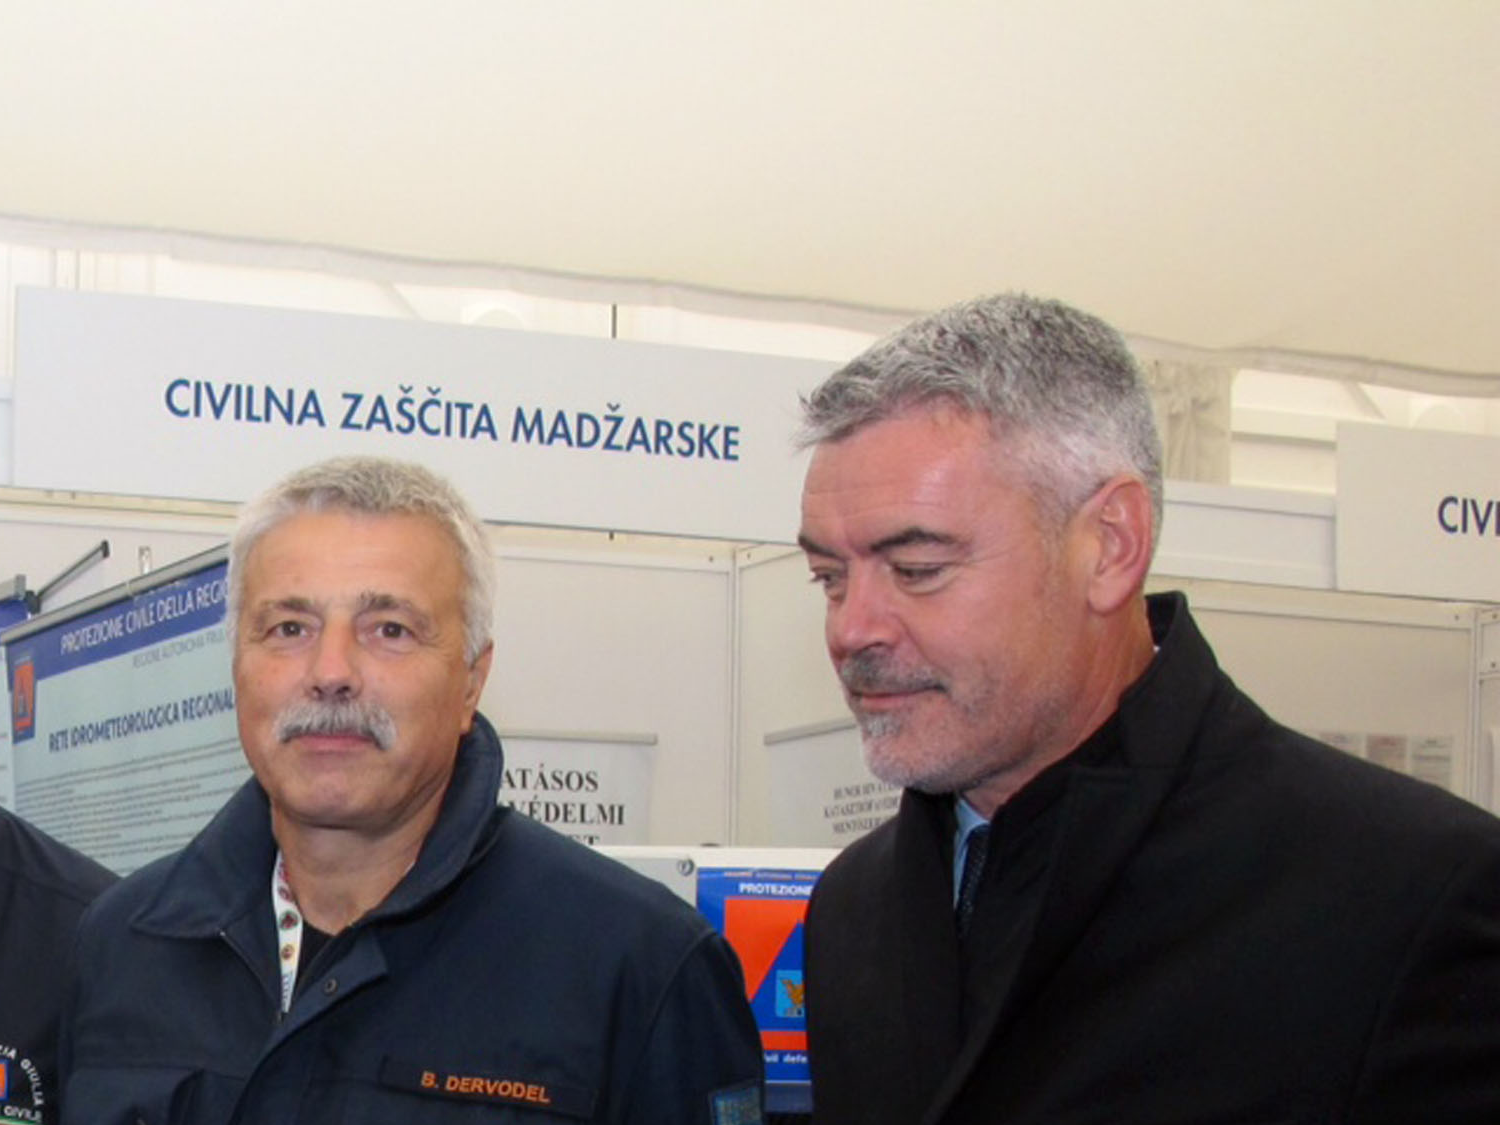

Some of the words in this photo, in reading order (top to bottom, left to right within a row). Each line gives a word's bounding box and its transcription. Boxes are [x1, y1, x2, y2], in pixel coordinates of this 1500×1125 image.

[165, 379, 324, 428] CIVILNA
[341, 384, 498, 443] ZAŠČITA
[510, 402, 740, 462] MADŽARSKE
[61, 615, 124, 654] PROTEZIONE
[126, 601, 156, 634] CIVILE
[157, 591, 195, 621] DELLA
[49, 727, 69, 752] RETE
[70, 702, 180, 748] IDROMETEOROLOGICA
[20, 1058, 45, 1107] GIULIA
[421, 1070, 439, 1089] B.
[445, 1075, 550, 1104] DERVODEL
